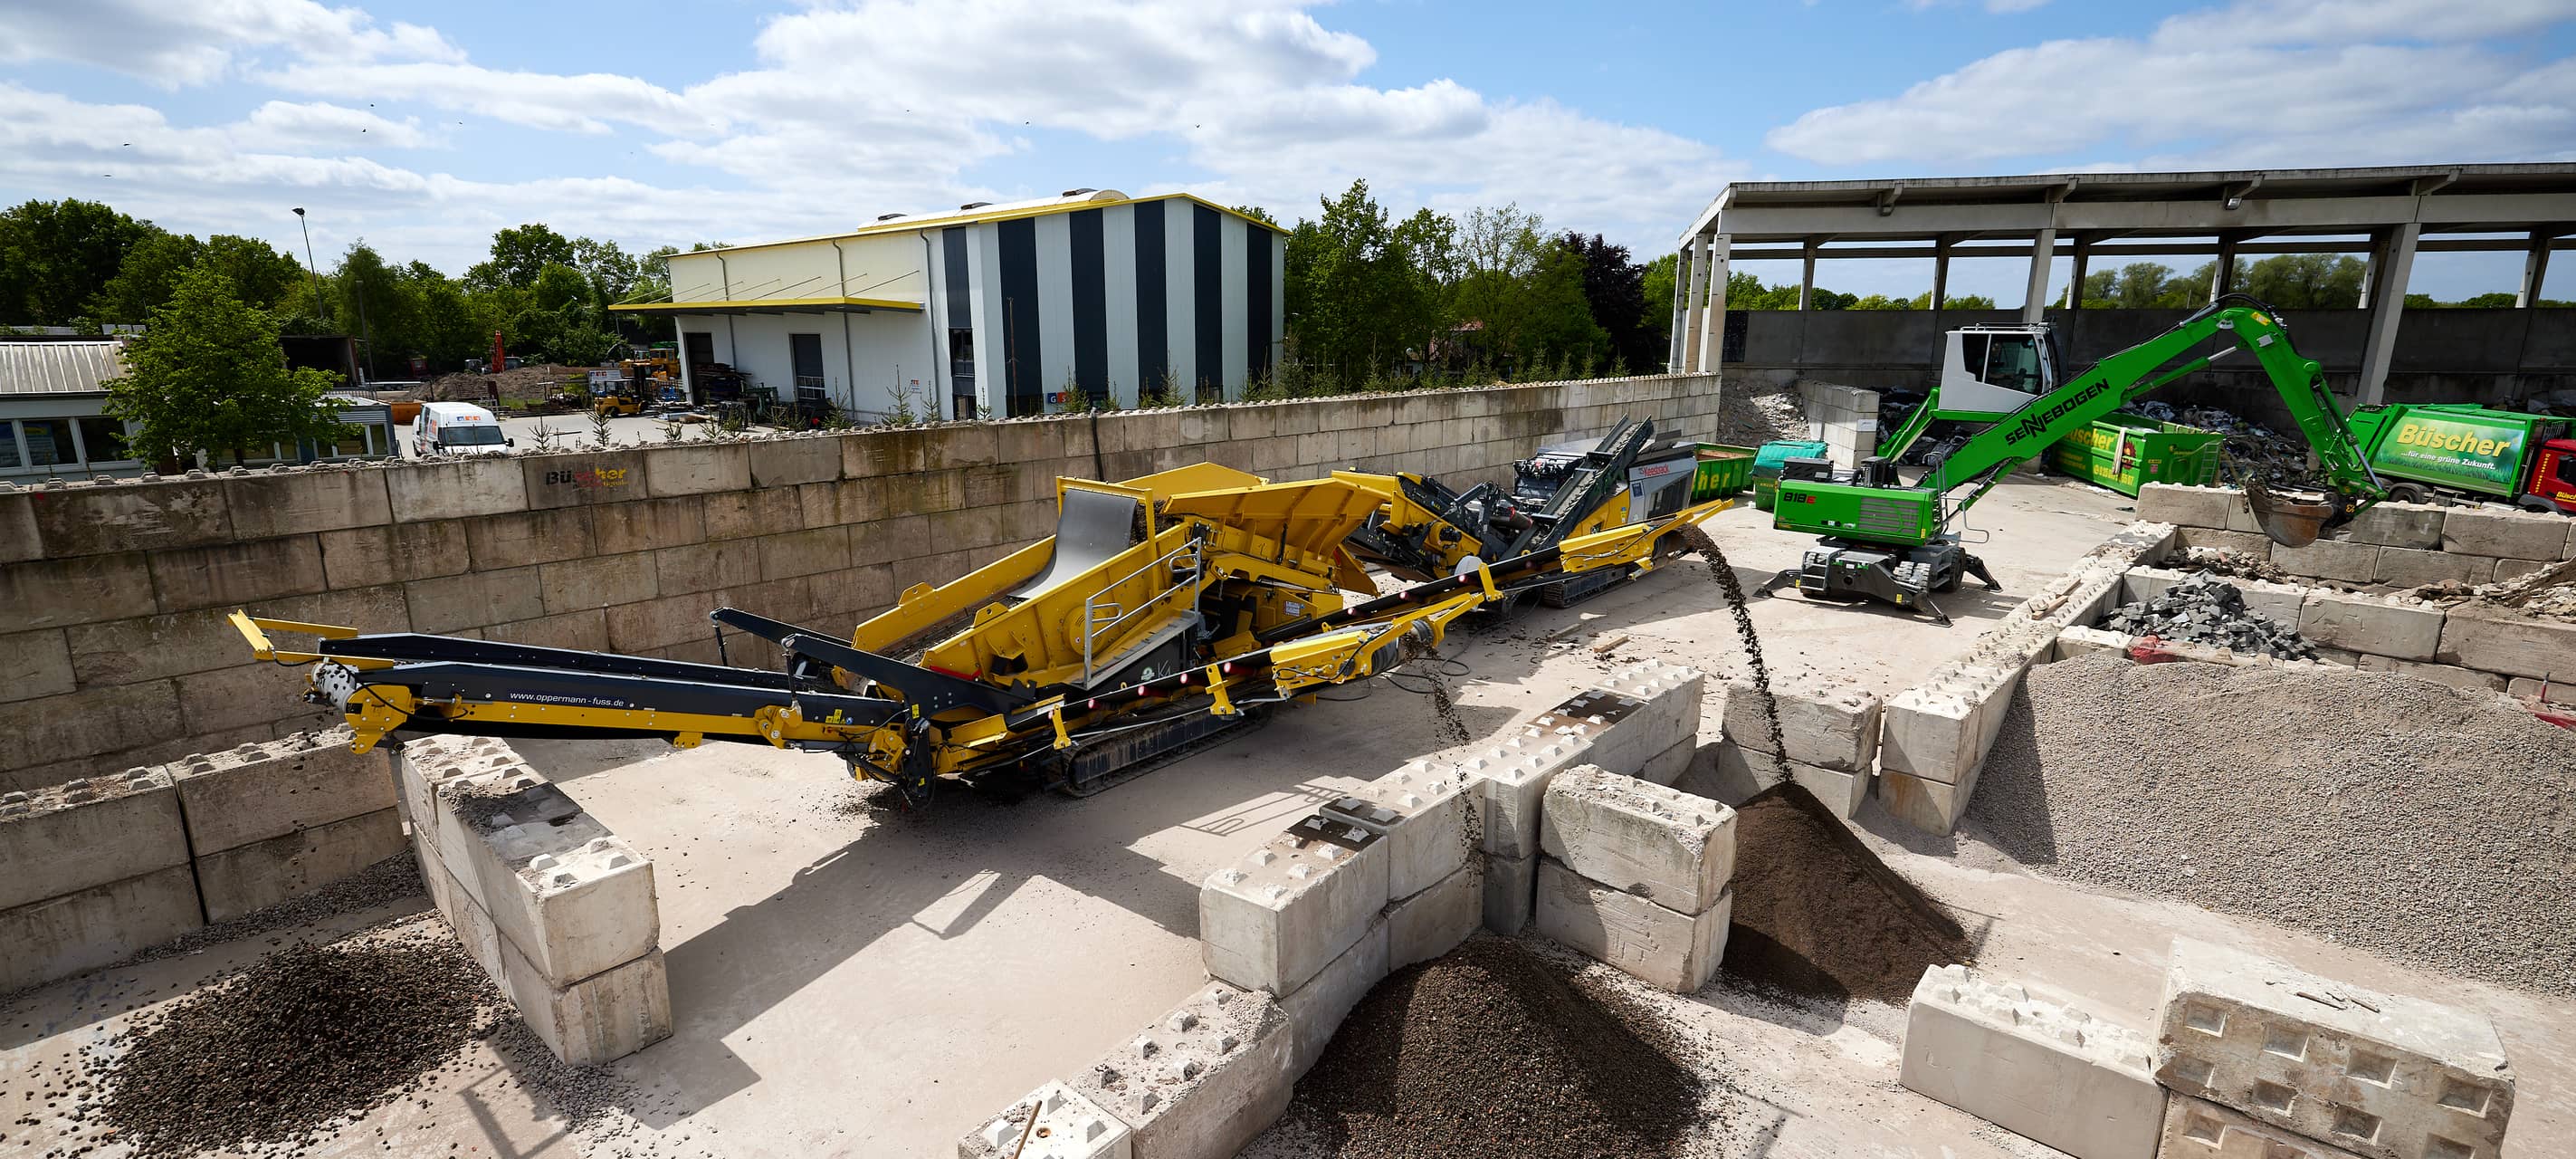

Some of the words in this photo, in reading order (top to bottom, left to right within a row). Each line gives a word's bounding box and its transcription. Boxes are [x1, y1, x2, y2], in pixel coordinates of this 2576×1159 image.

[2005, 378, 2110, 445] SENNEBOGEN
[2397, 424, 2511, 457] Büscher
[2438, 456, 2460, 465] grüne
[2462, 458, 2496, 470] Zukunft.
[1783, 492, 1817, 504] 818E
